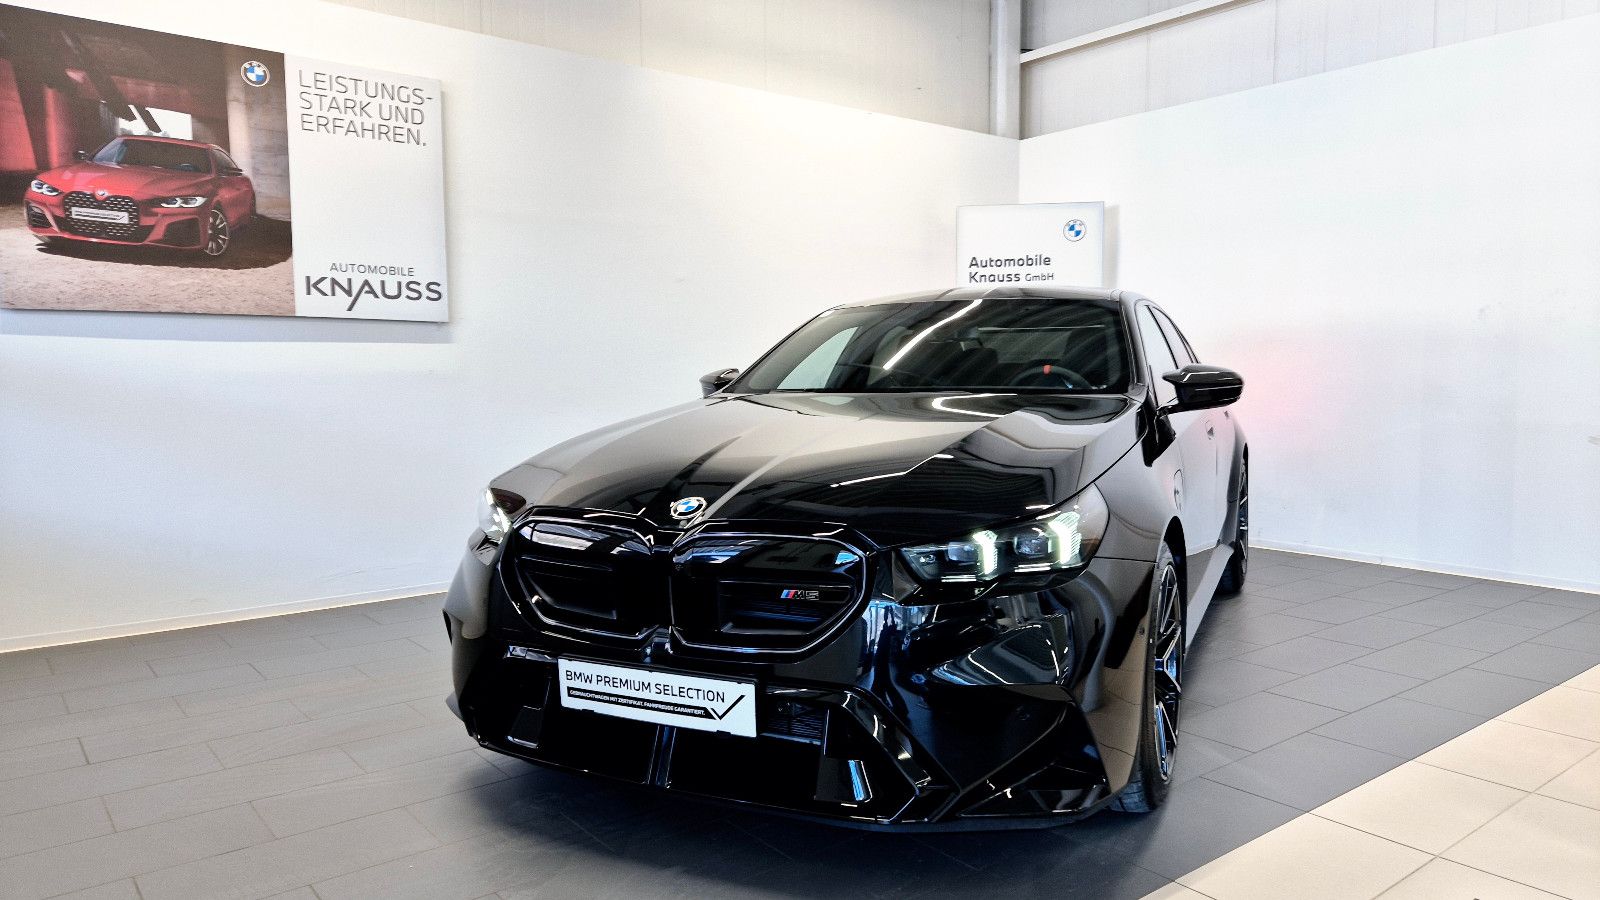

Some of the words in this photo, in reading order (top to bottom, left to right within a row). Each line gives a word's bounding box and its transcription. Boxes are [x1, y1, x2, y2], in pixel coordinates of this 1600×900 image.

[299, 69, 434, 106] LEISTUNGS-
[299, 91, 373, 119] STARK
[378, 103, 425, 126] UND
[300, 113, 428, 147] ERFAHREN.
[330, 262, 415, 277] AUTOMOBILE
[968, 254, 1052, 269] Automobile
[968, 271, 1021, 284] Knauss
[1024, 272, 1055, 282] GmbH
[305, 275, 443, 312] KNAUSS
[565, 670, 593, 685] BMW
[596, 675, 652, 693] PREMIUM
[654, 683, 725, 703] SELECTION
